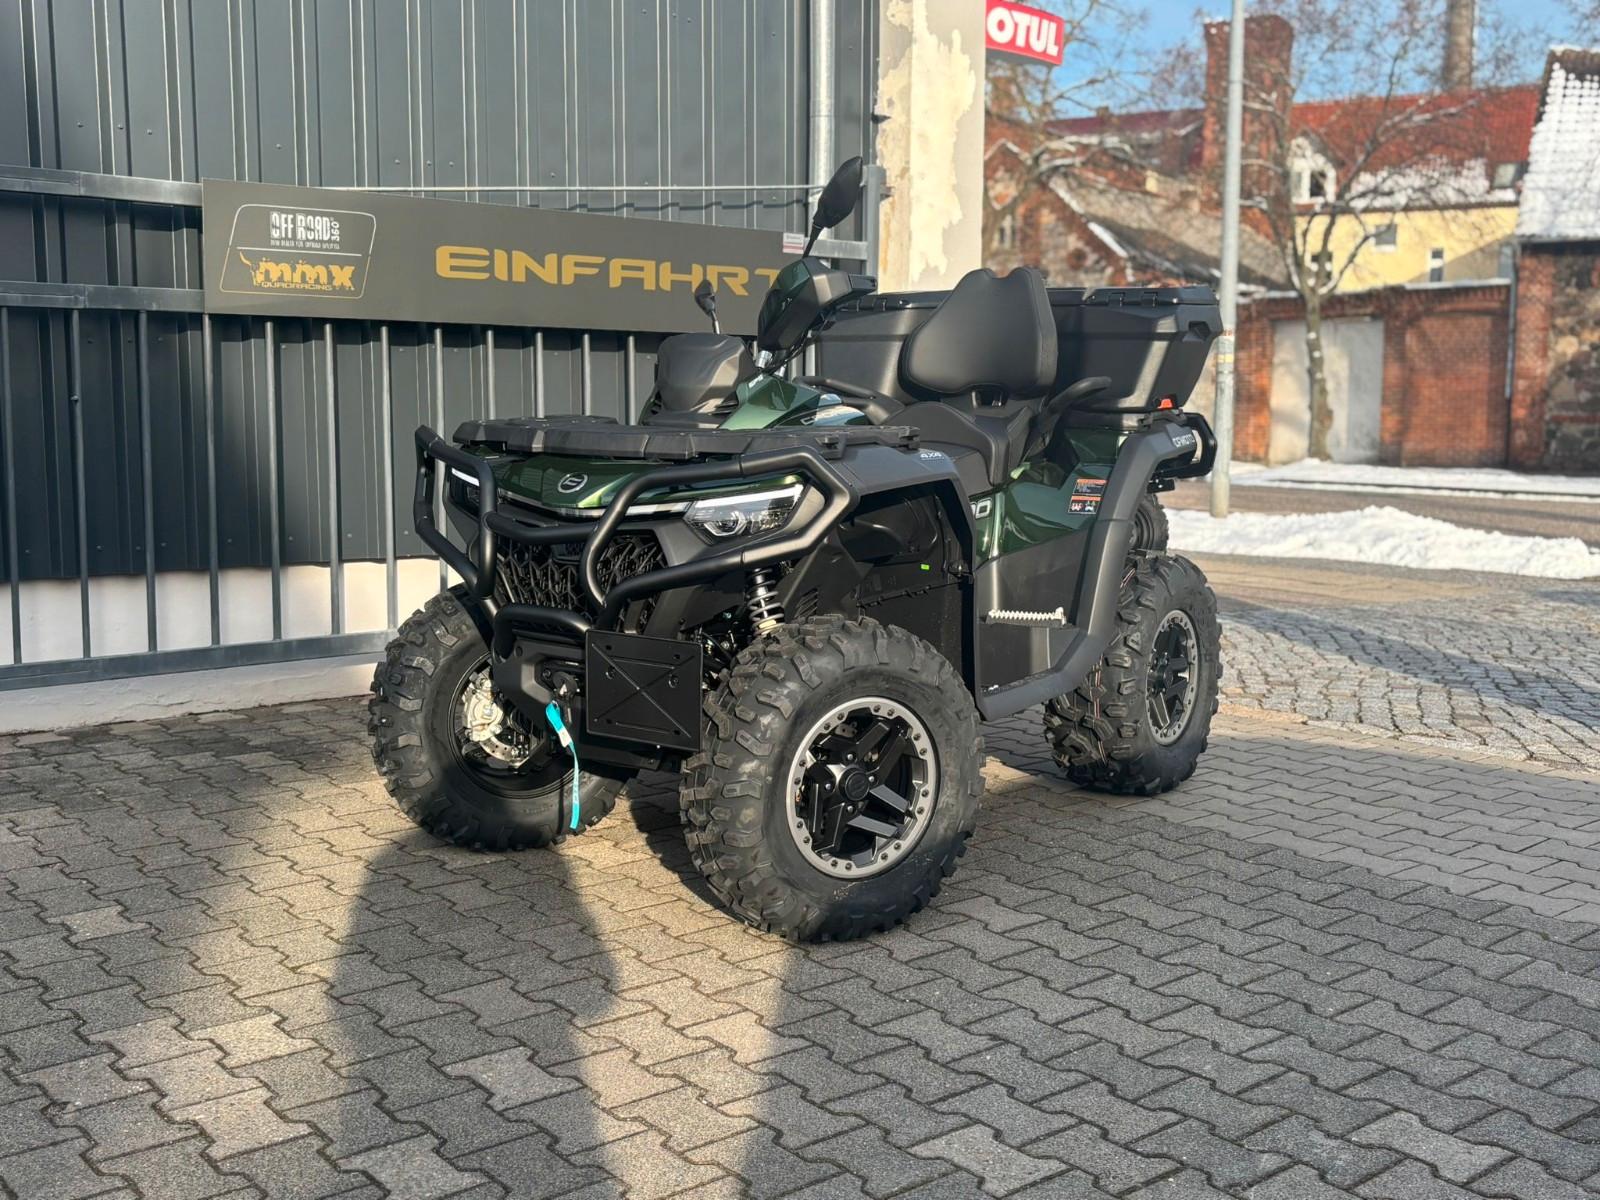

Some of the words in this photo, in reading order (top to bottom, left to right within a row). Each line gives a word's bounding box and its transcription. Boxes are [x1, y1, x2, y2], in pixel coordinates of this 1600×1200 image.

[987, 7, 1059, 57] OTUL
[271, 212, 294, 239] OFF
[296, 213, 331, 241] ROAD
